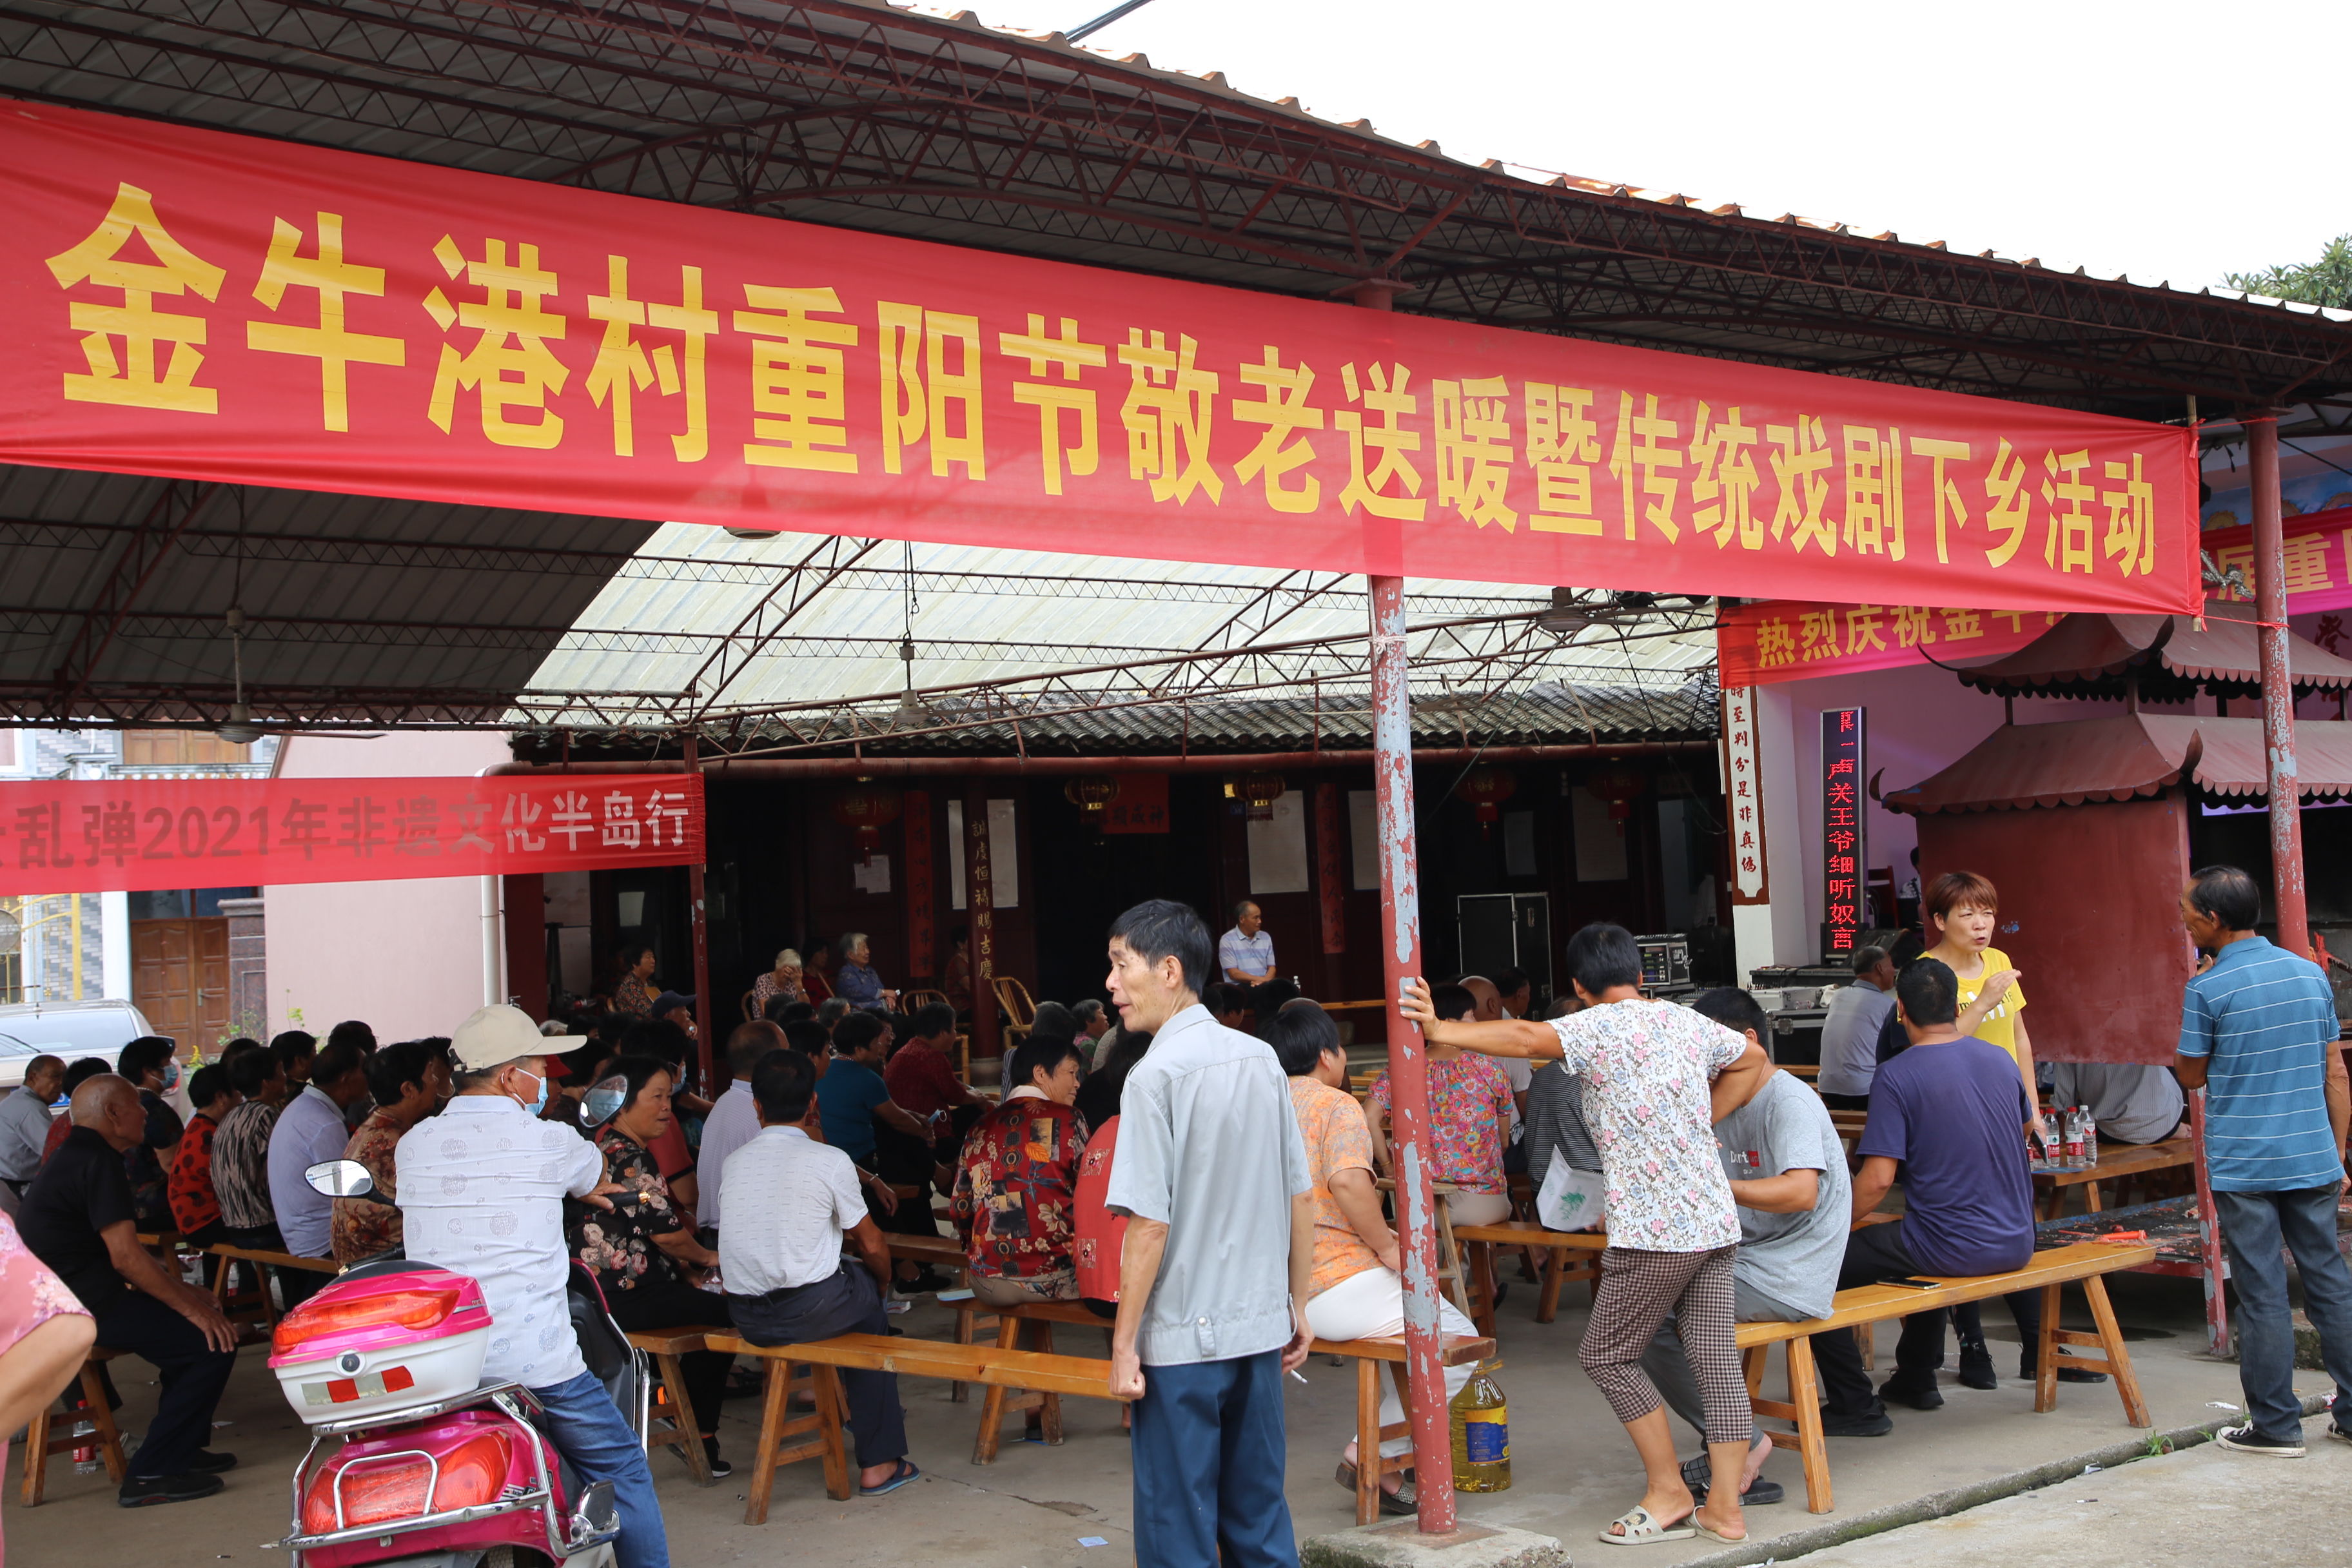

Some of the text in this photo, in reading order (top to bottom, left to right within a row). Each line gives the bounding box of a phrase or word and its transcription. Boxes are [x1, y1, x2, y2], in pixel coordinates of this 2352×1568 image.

[45, 182, 2155, 578] 金牛港村重阳节敬老送暖暨传统戏剧下乡活动
[0, 790, 689, 870] 乱弹2021年非遗文化半岛行
